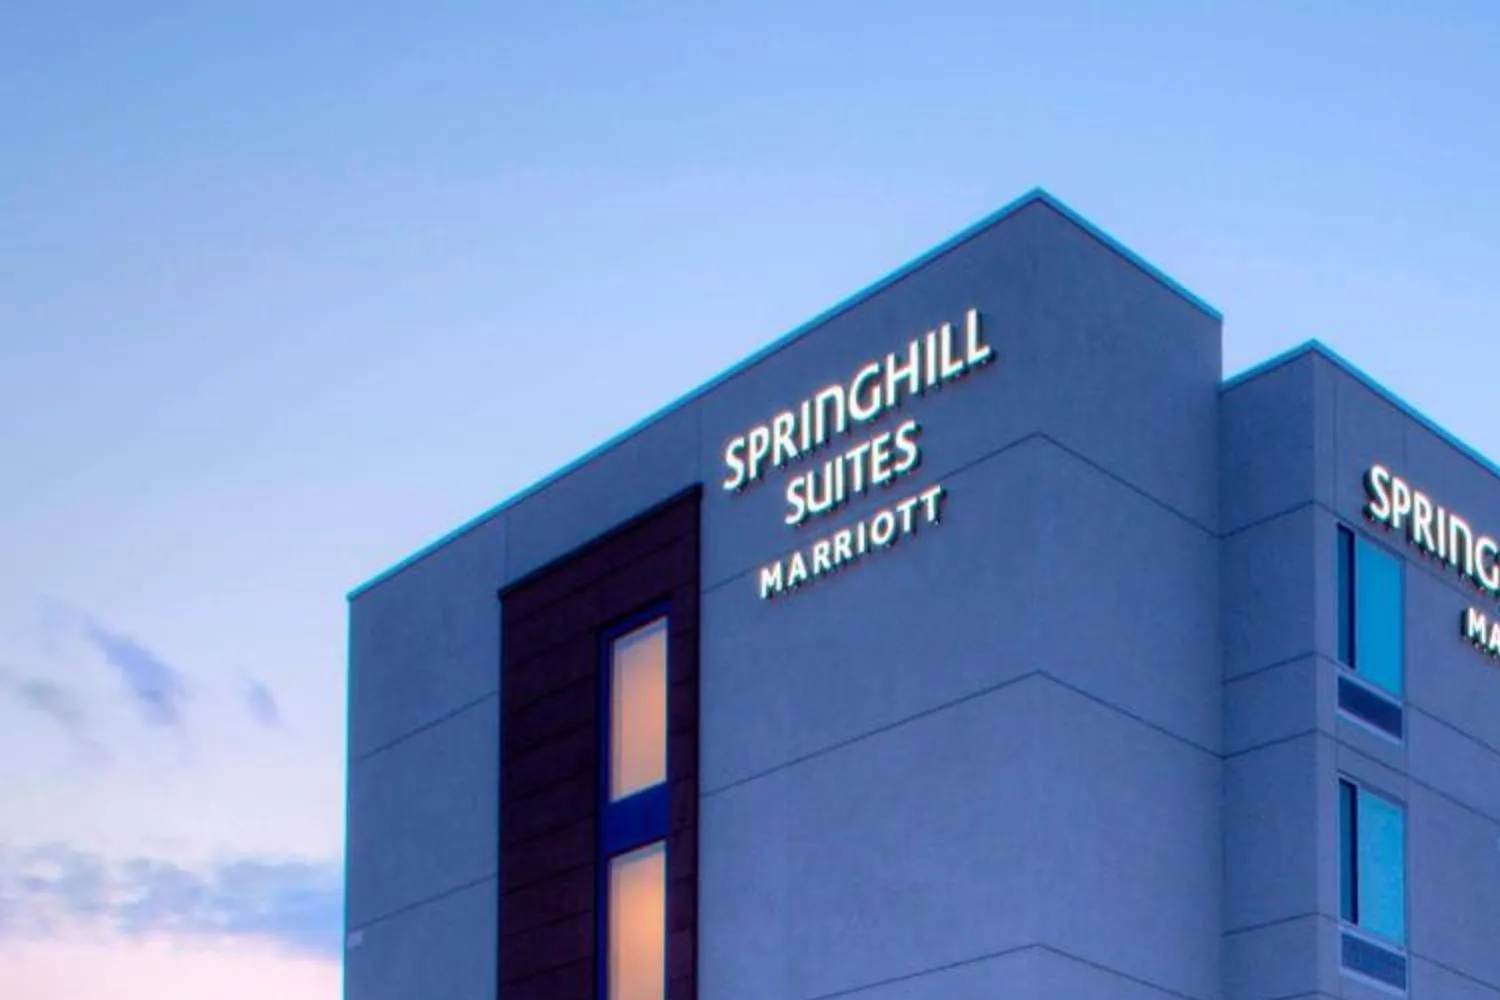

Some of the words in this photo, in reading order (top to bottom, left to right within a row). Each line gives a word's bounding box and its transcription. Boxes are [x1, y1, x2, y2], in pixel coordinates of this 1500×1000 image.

[722, 307, 992, 491] SPRINGHILL
[784, 419, 918, 525] SUITES
[759, 484, 943, 599] MARRIOTT
